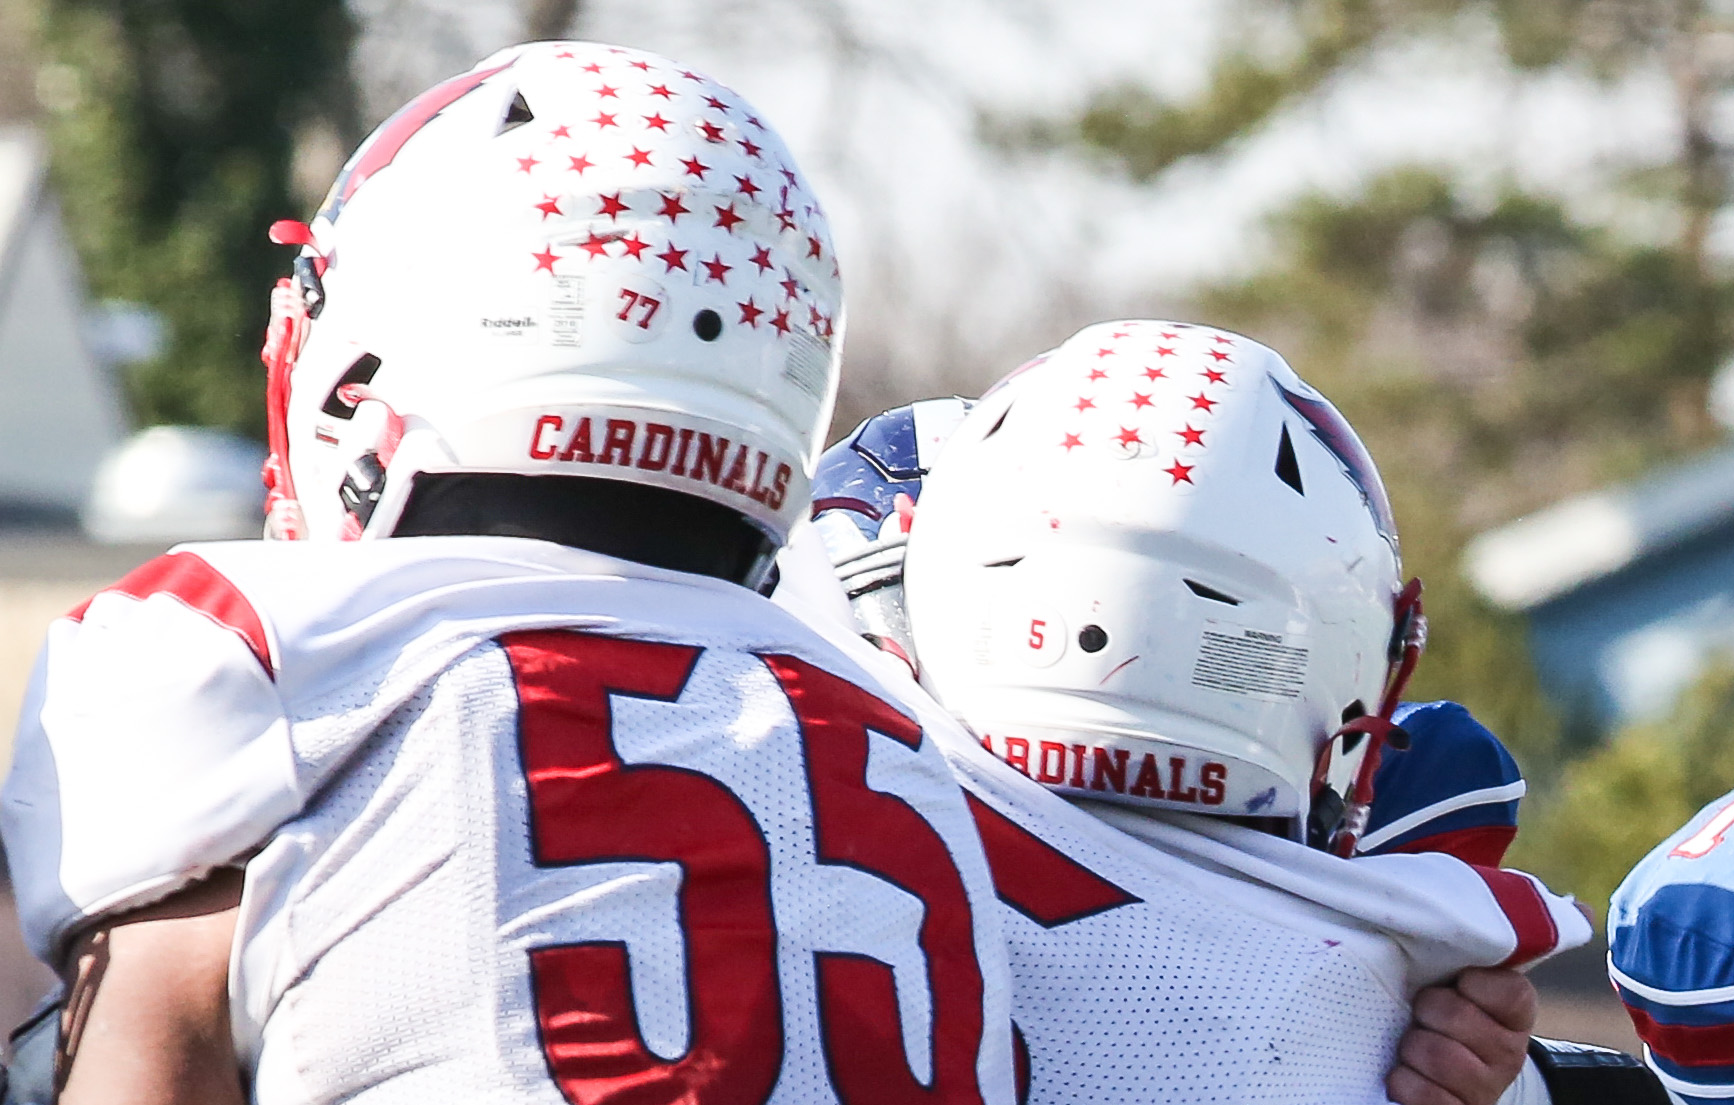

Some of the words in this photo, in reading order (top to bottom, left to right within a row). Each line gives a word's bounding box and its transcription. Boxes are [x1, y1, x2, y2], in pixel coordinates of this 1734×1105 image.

[615, 287, 662, 331] 77
[529, 414, 793, 511] CARDINALS
[1028, 618, 1047, 650] 5
[980, 734, 1227, 806] RDINALS
